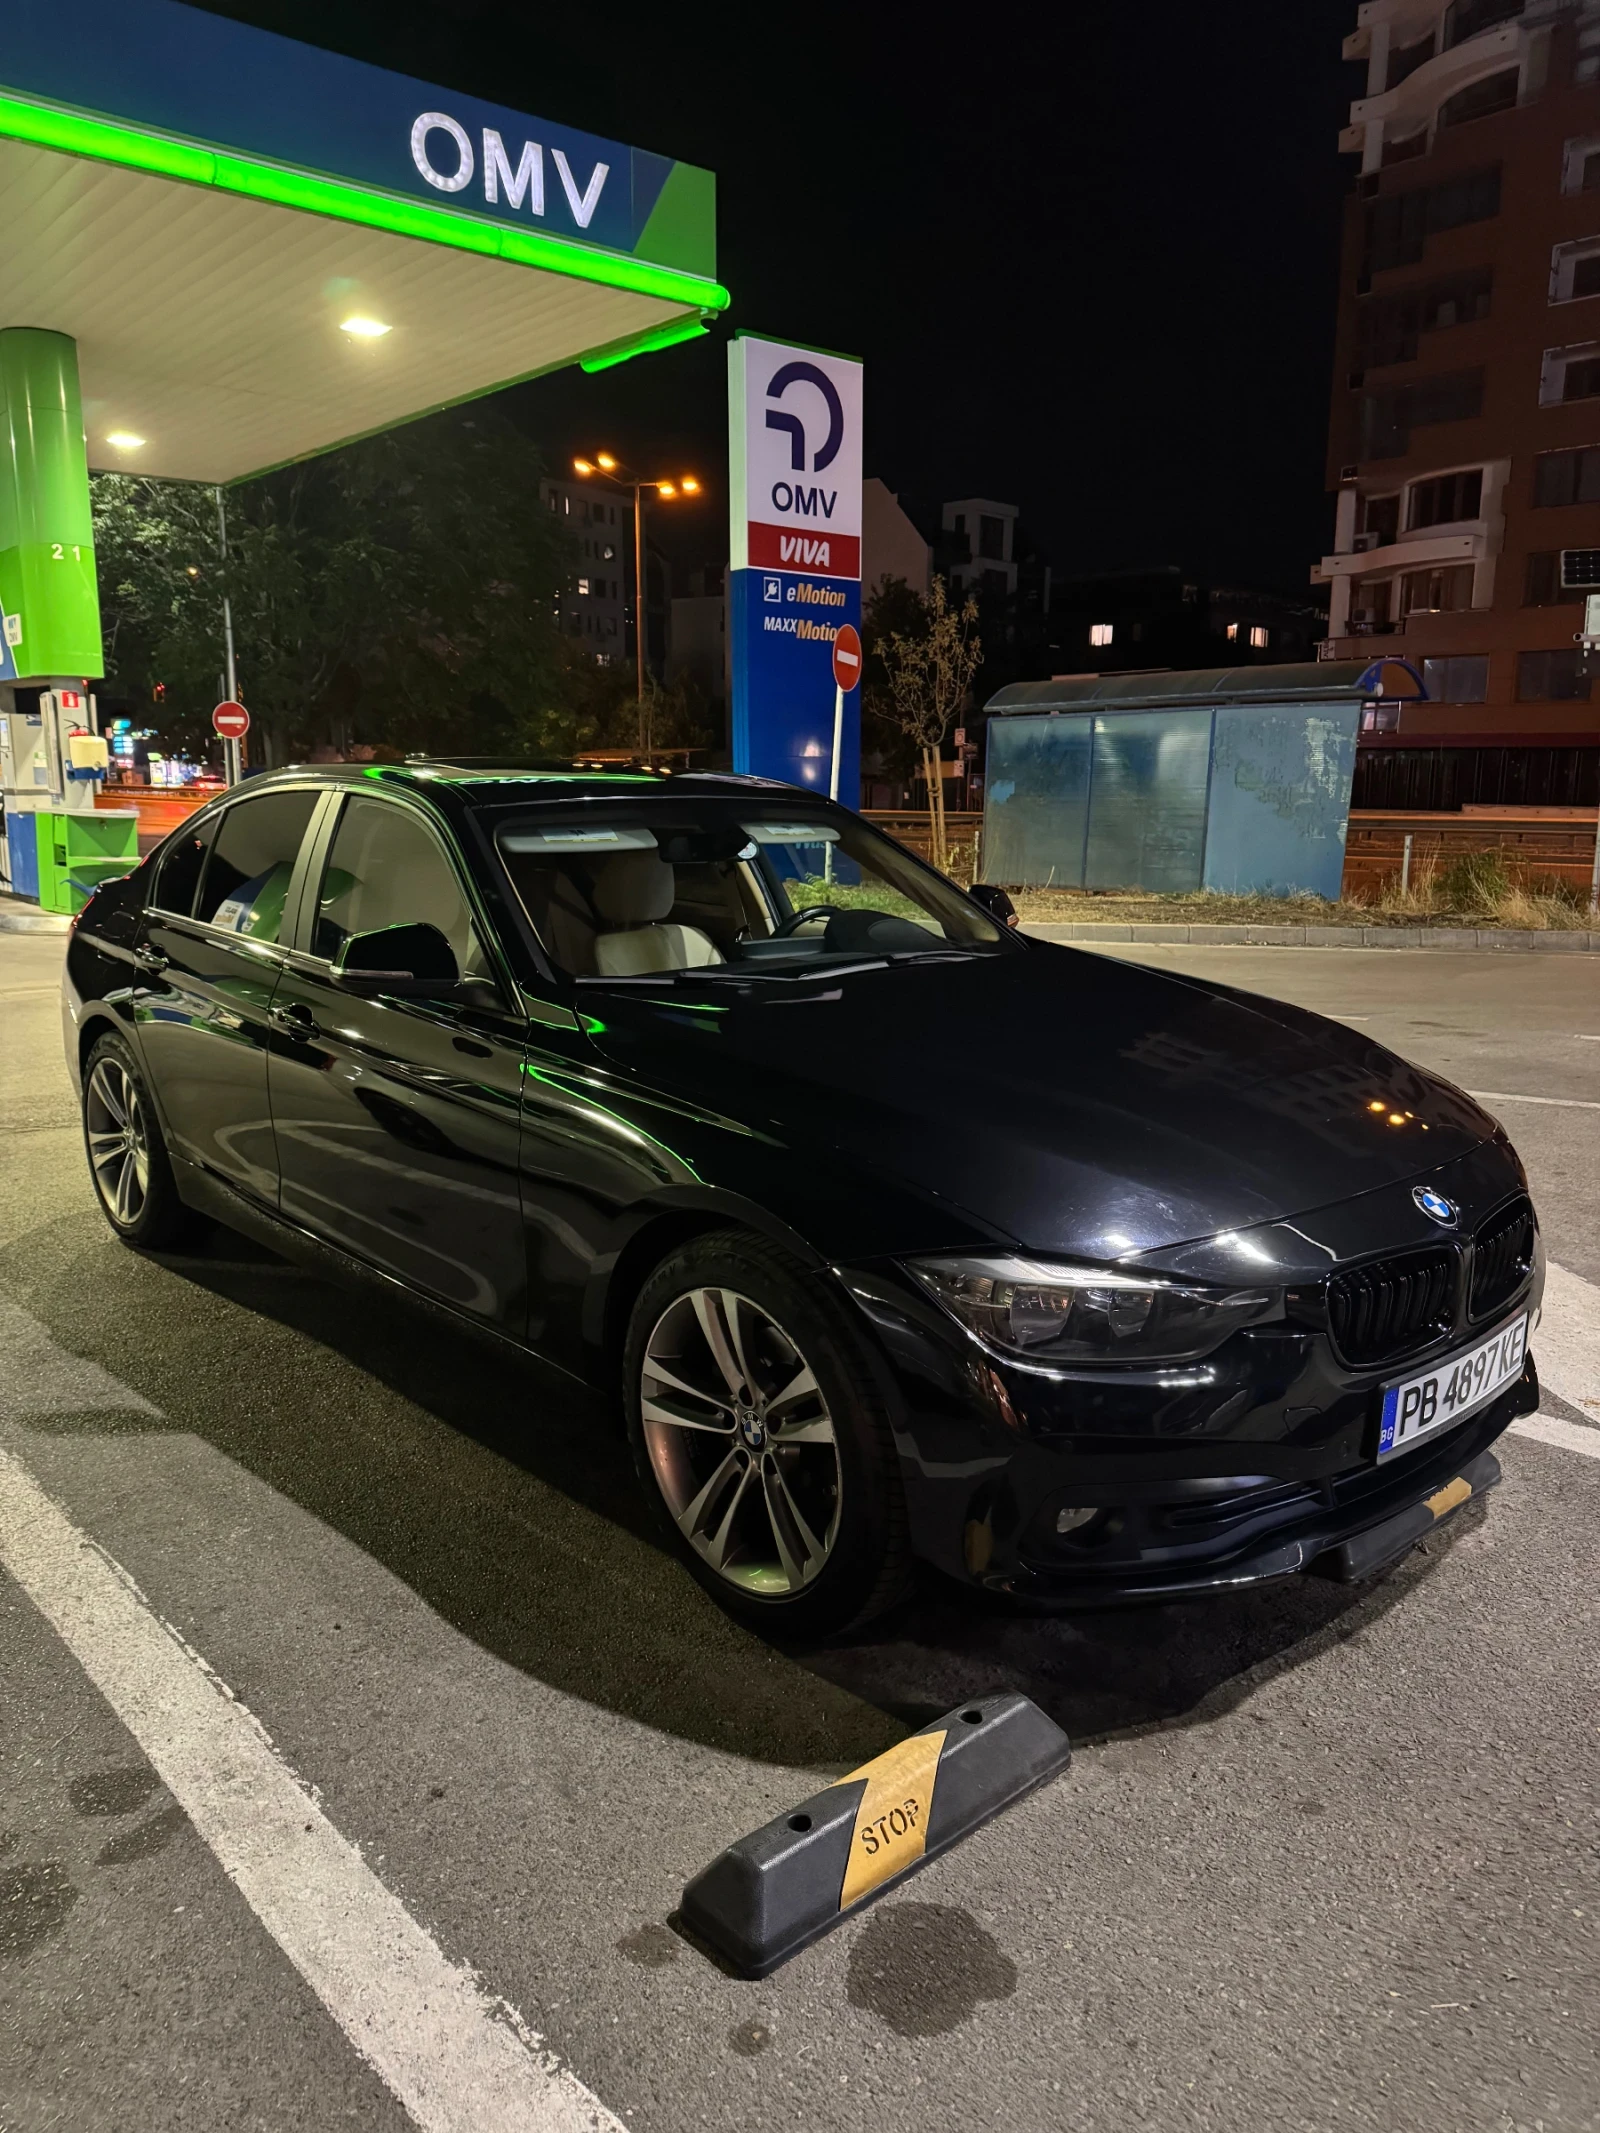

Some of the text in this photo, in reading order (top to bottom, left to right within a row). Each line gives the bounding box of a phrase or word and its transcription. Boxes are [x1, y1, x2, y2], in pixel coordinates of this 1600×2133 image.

[411, 112, 609, 228] OMV
[772, 482, 837, 518] OMV
[780, 535, 830, 568] VIVA
[787, 582, 846, 606] eMotion
[764, 616, 840, 641] MAXXMotio
[1399, 1377, 1438, 1437] PB
[1442, 1340, 1499, 1411] 4897
[1499, 1321, 1525, 1378] KE
[1380, 1426, 1394, 1444] BG
[860, 1798, 919, 1855] STOP
